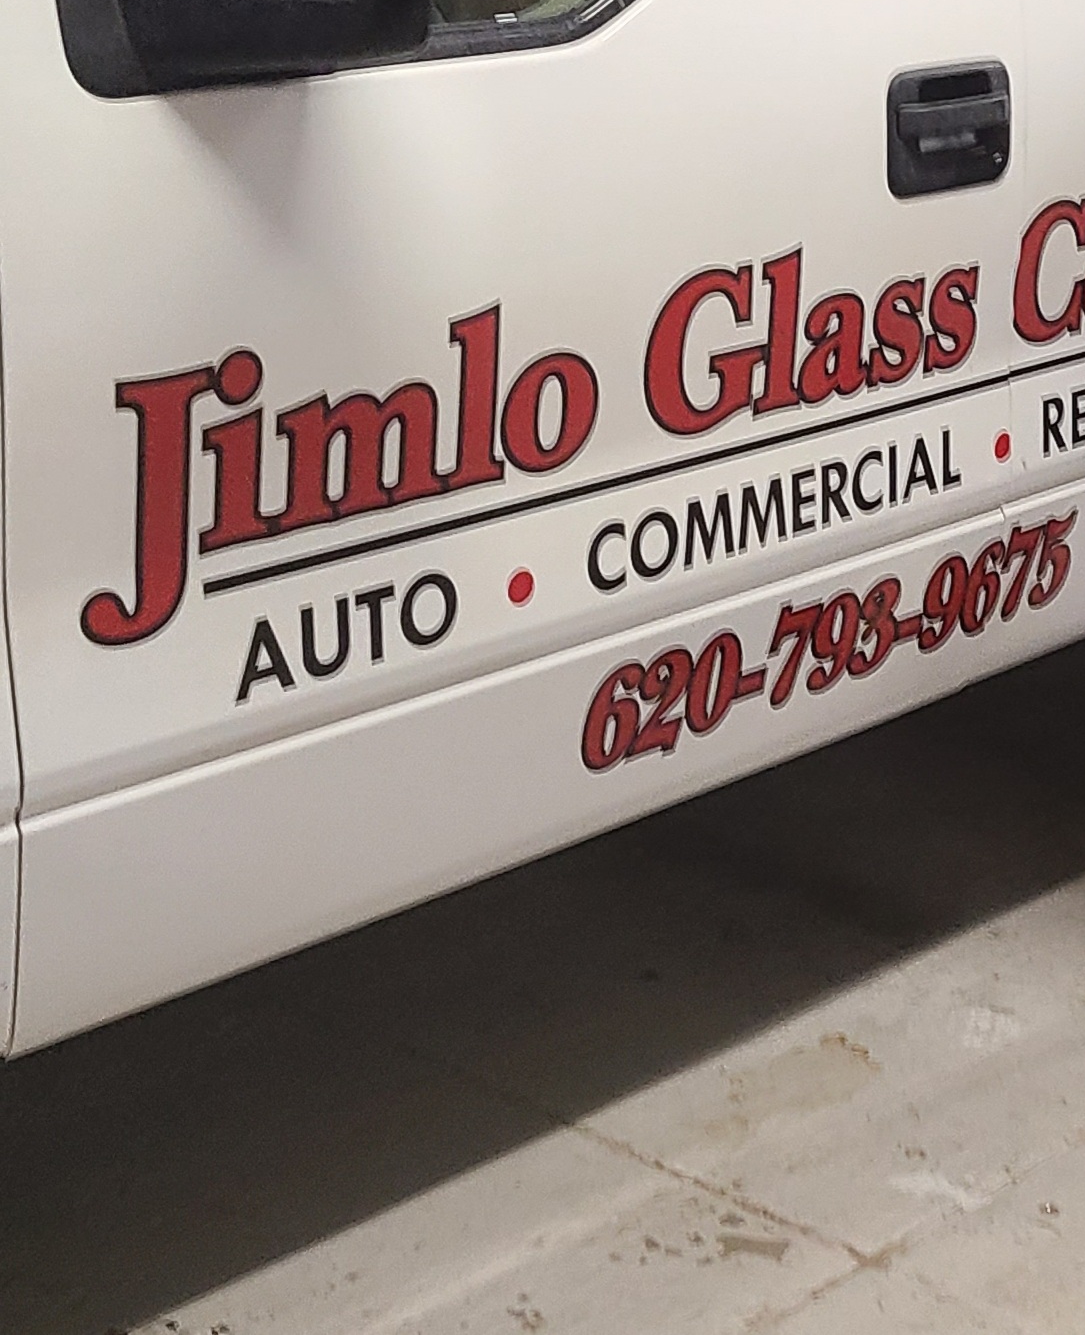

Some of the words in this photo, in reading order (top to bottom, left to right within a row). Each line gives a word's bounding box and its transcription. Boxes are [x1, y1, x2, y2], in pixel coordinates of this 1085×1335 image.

[80, 303, 599, 646] Jimlo
[643, 245, 980, 436] Glass
[236, 570, 457, 705] AUTO
[586, 428, 961, 593] COMMERCIAL
[580, 510, 1076, 771] 620-793-9675
